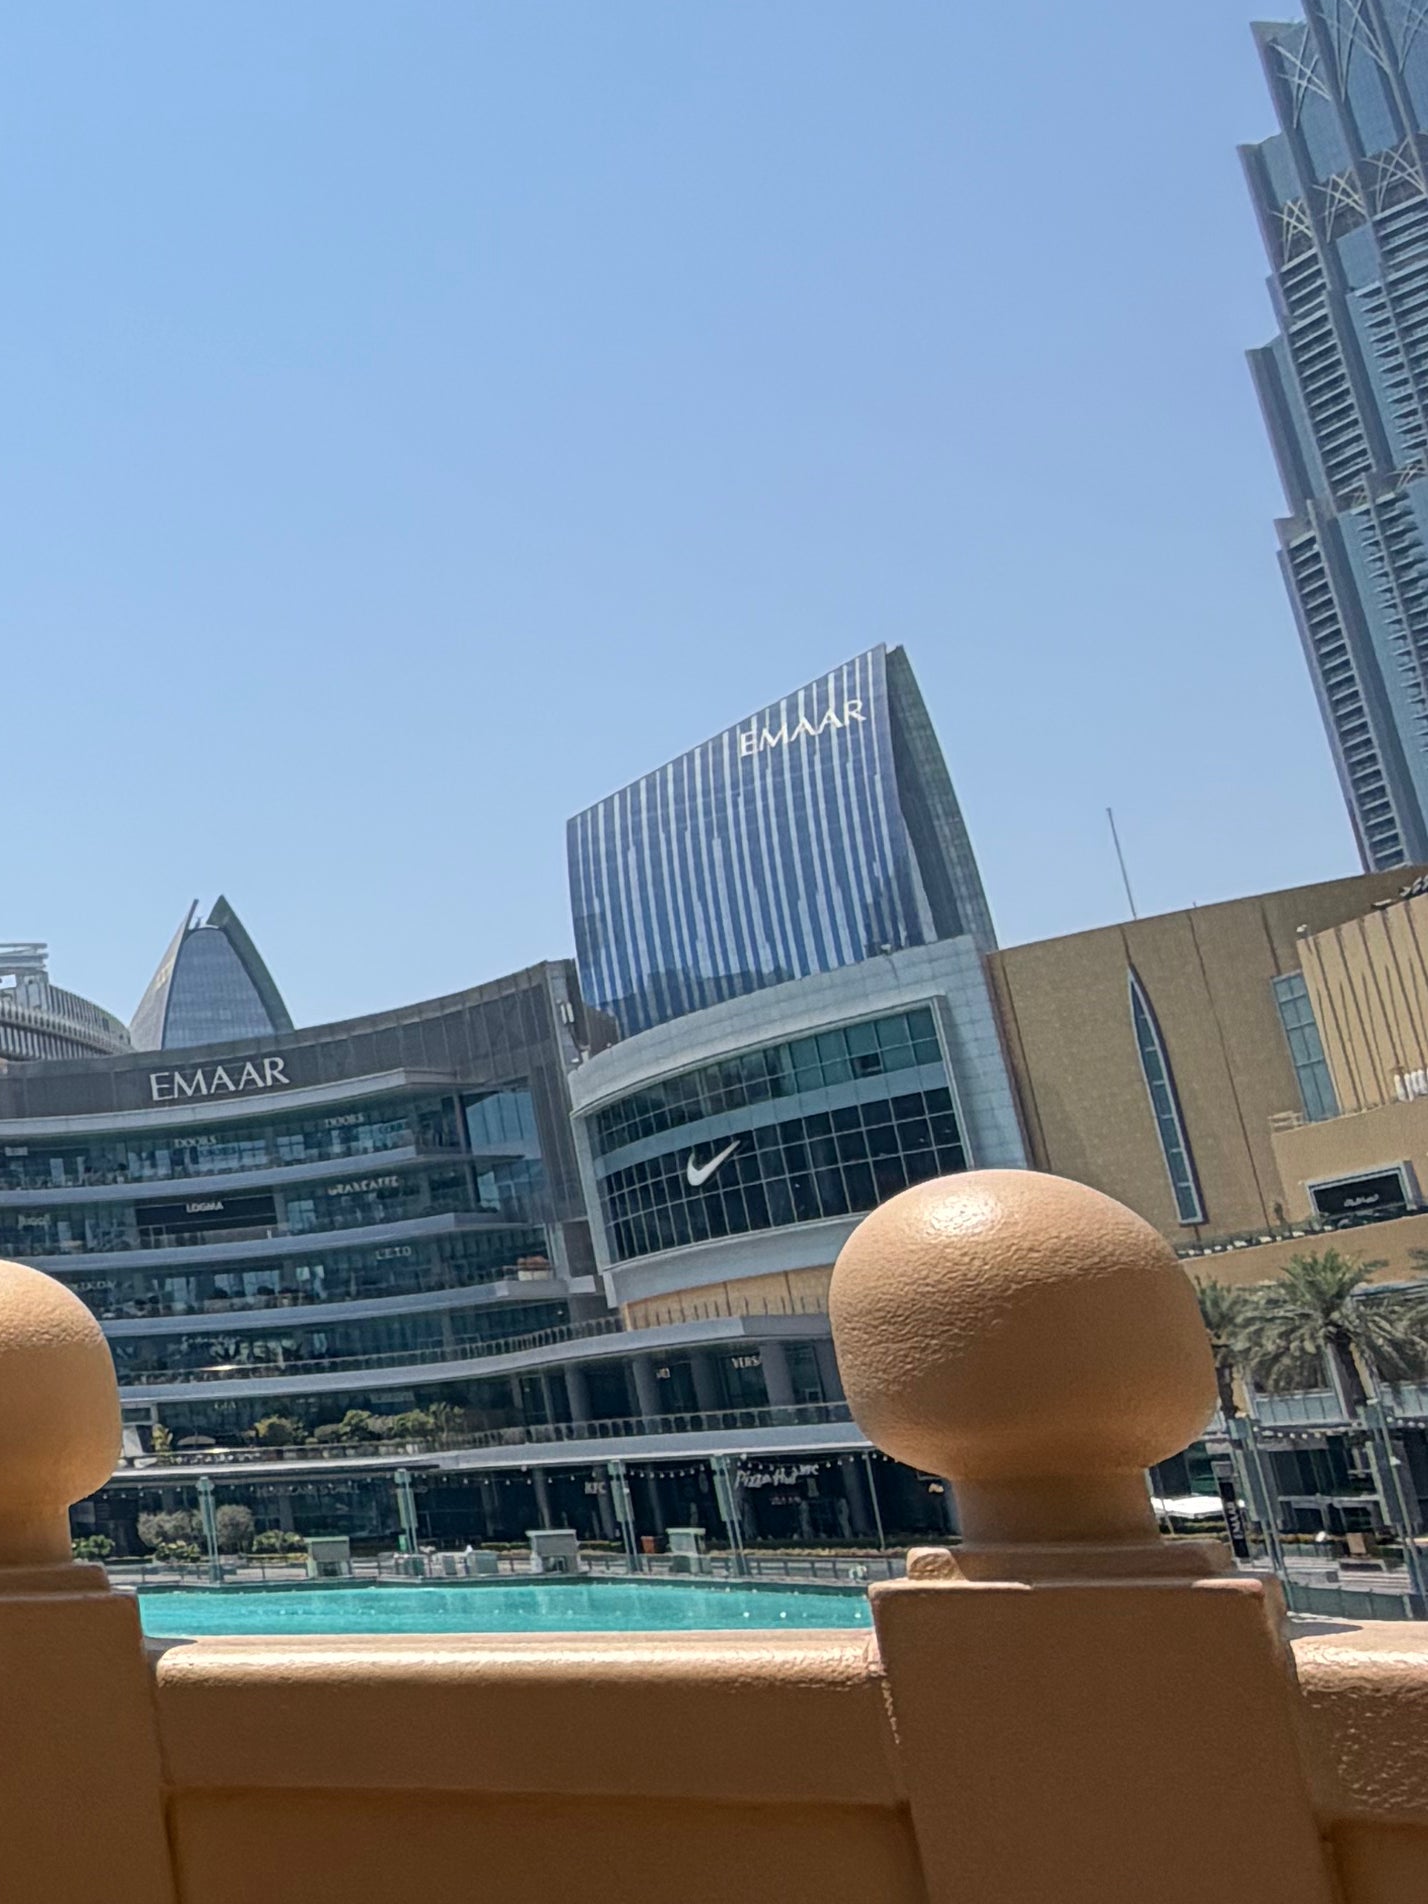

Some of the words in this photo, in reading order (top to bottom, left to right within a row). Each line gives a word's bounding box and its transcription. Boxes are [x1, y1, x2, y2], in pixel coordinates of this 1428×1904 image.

[740, 698, 867, 757] EMAAR
[150, 1057, 290, 1101] EMAAR
[186, 1201, 224, 1214] LOGMA
[735, 1469, 772, 1490] Pizza
[773, 1465, 799, 1487] Hut
